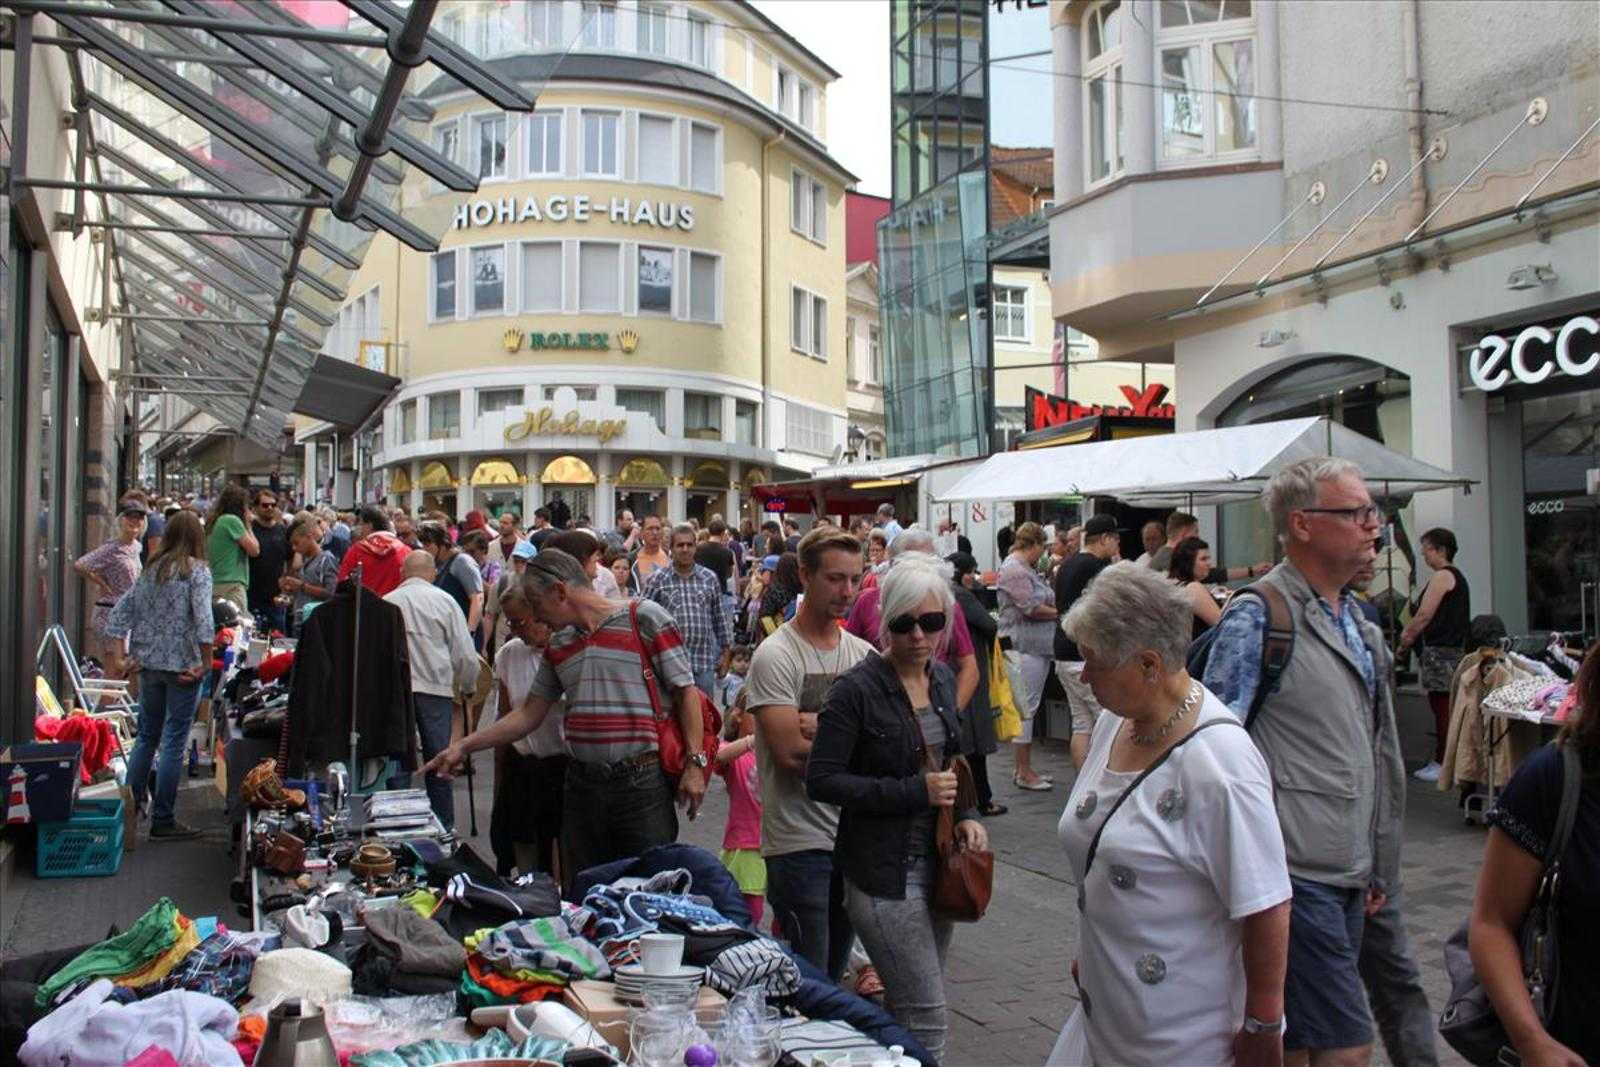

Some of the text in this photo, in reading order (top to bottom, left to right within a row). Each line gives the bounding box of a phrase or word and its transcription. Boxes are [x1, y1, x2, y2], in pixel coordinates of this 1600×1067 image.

[453, 194, 696, 231] HOHAGE-HAUS
[530, 332, 610, 350] ROLEX
[1527, 501, 1565, 515] ecco
